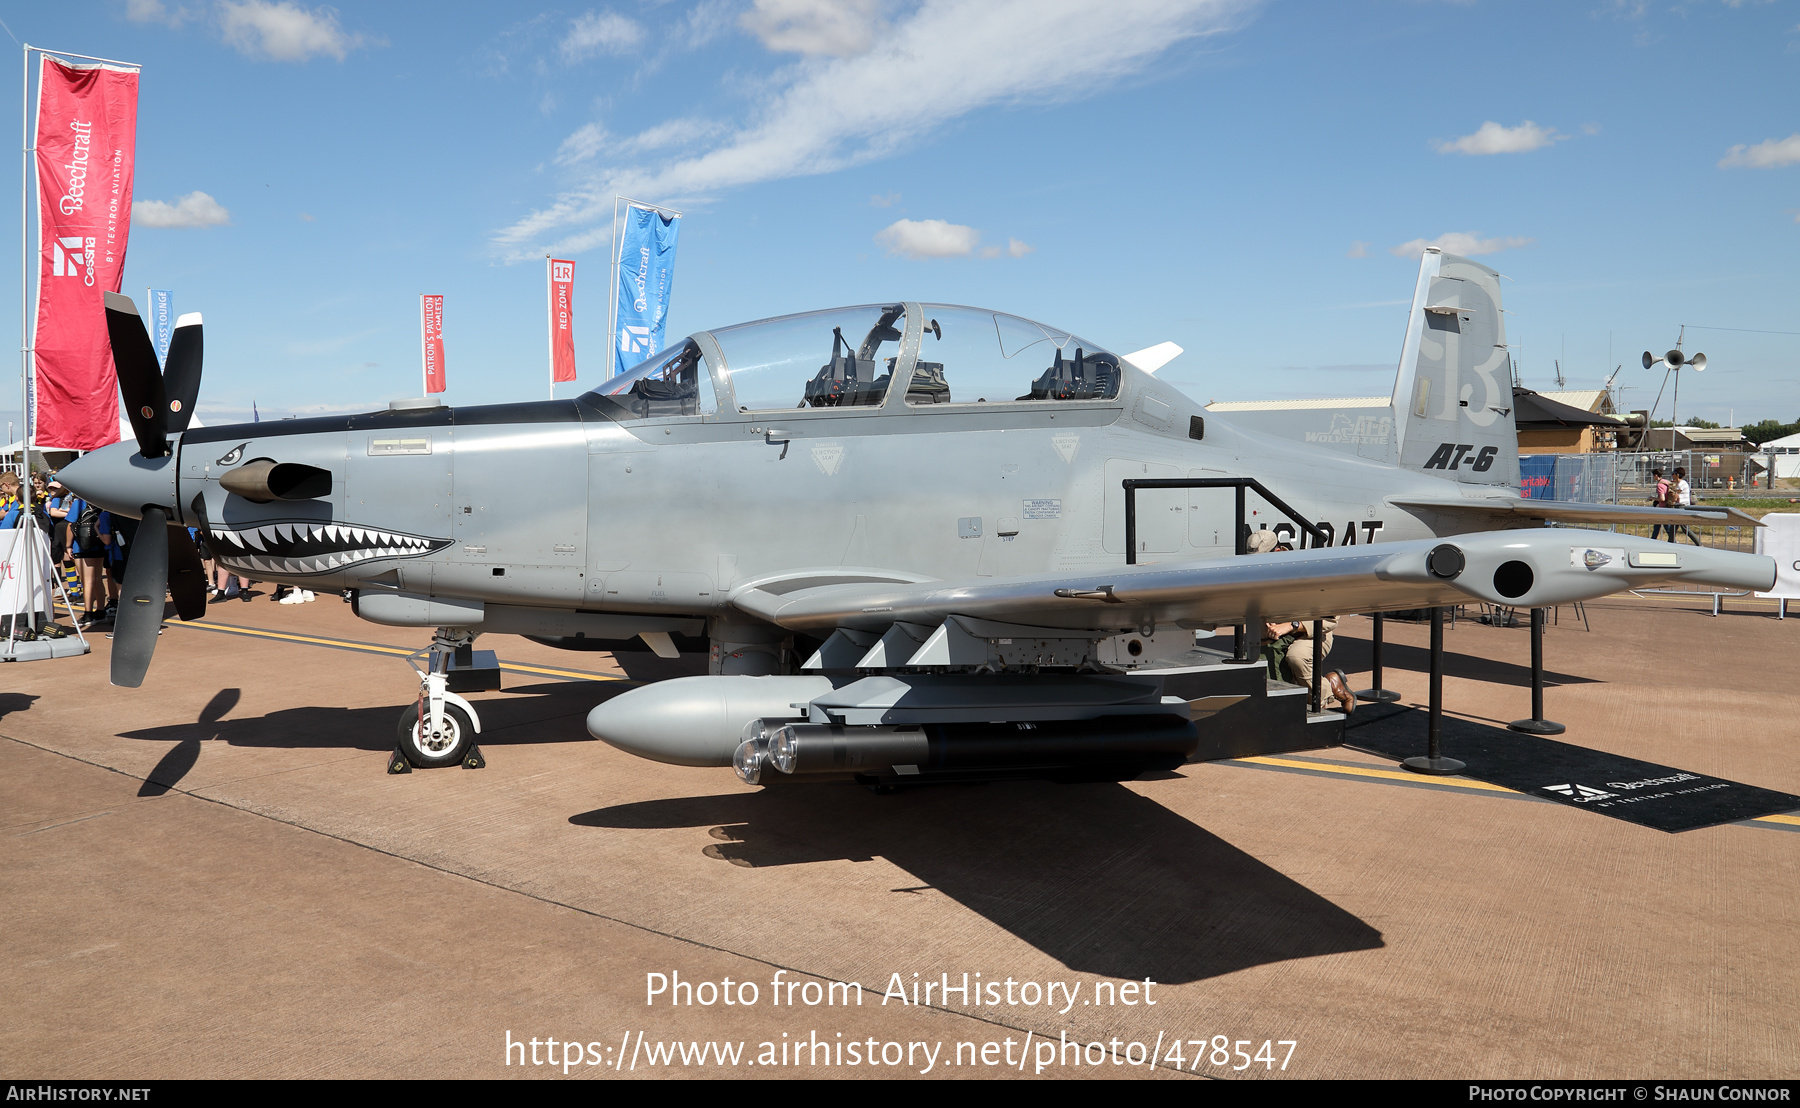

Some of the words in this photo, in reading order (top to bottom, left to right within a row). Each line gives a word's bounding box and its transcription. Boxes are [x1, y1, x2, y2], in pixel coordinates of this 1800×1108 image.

[60, 119, 92, 216] Beechcraft
[111, 149, 122, 194] AVIATION
[108, 199, 118, 244] TEXTRON
[84, 237, 96, 287] Cessna
[106, 250, 114, 262] BY
[555, 266, 571, 279] 1R
[559, 284, 567, 309] ZONE
[634, 247, 650, 313] Beechcraft
[658, 268, 667, 302] AVIATION
[157, 291, 168, 325] LOUNGE
[425, 297, 434, 334] PAVILION
[560, 311, 568, 330] RED
[159, 328, 168, 353] CLASS
[1423, 443, 1499, 472] AT-6
[1521, 488, 1532, 498] ust
